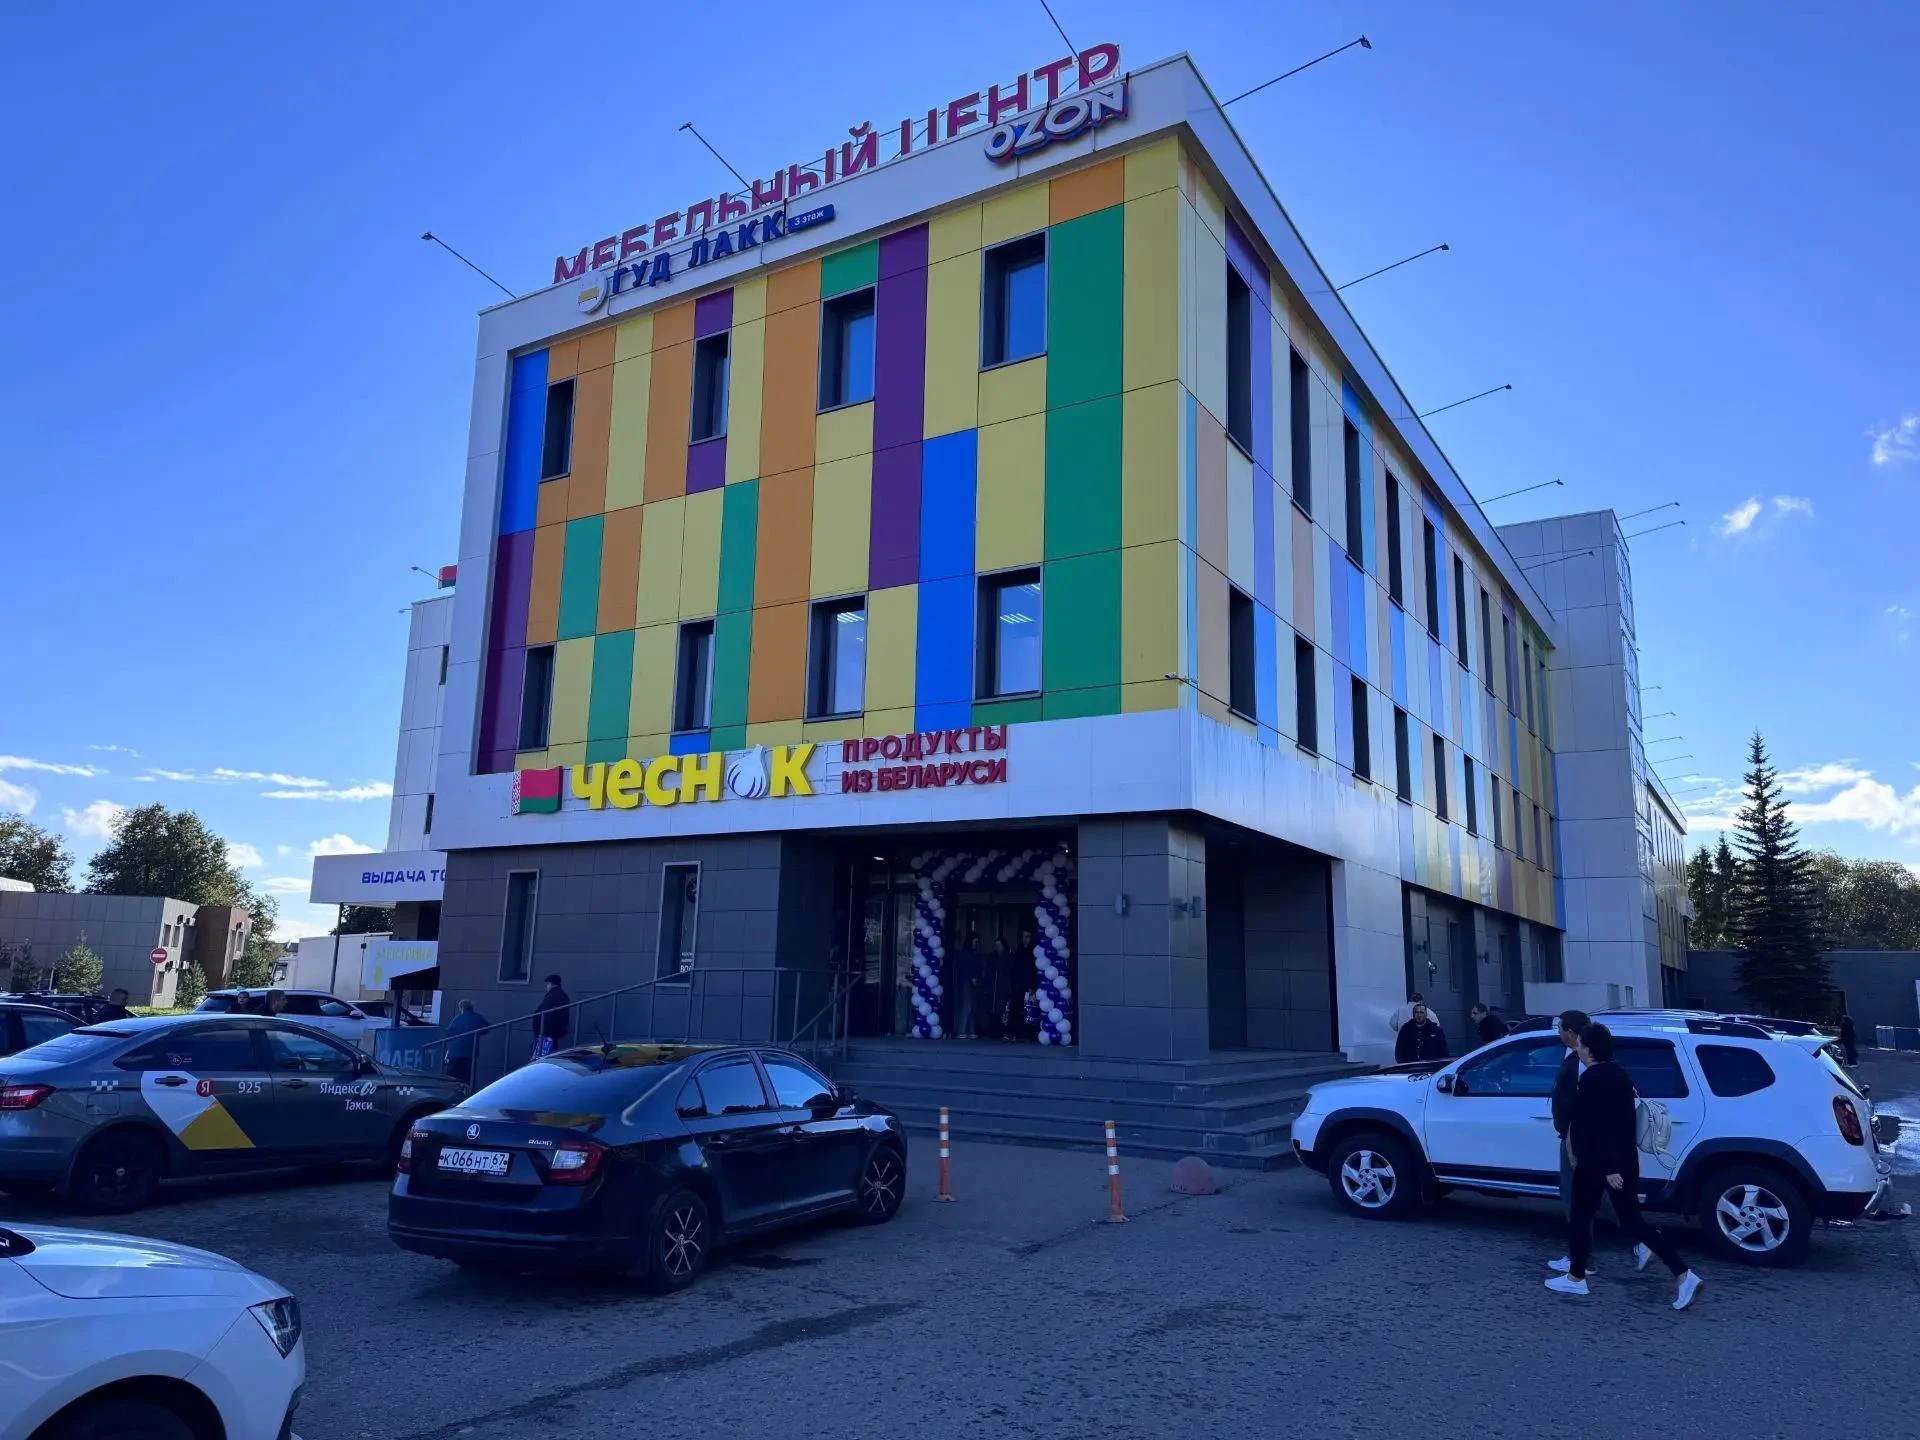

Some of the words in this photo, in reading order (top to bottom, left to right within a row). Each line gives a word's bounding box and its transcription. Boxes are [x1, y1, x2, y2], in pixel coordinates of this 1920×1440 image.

[983, 82, 1128, 161] OZON
[552, 121, 880, 284] МЕБЕЛЬНЫЙ
[795, 217, 801, 226] 3
[802, 210, 824, 223] этаж
[612, 252, 670, 294] ГУД
[688, 210, 784, 268] ЛАКК
[842, 724, 1007, 763] ПРОДУКТЫ
[841, 769, 872, 793] ИЗ
[877, 758, 1007, 791] БЕЛАРУСИ
[361, 870, 426, 884] ВЫДАЧА
[201, 1081, 211, 1093] Я
[238, 1081, 261, 1094] 925
[320, 1082, 360, 1095] Яндекс
[344, 1099, 373, 1110] Такси
